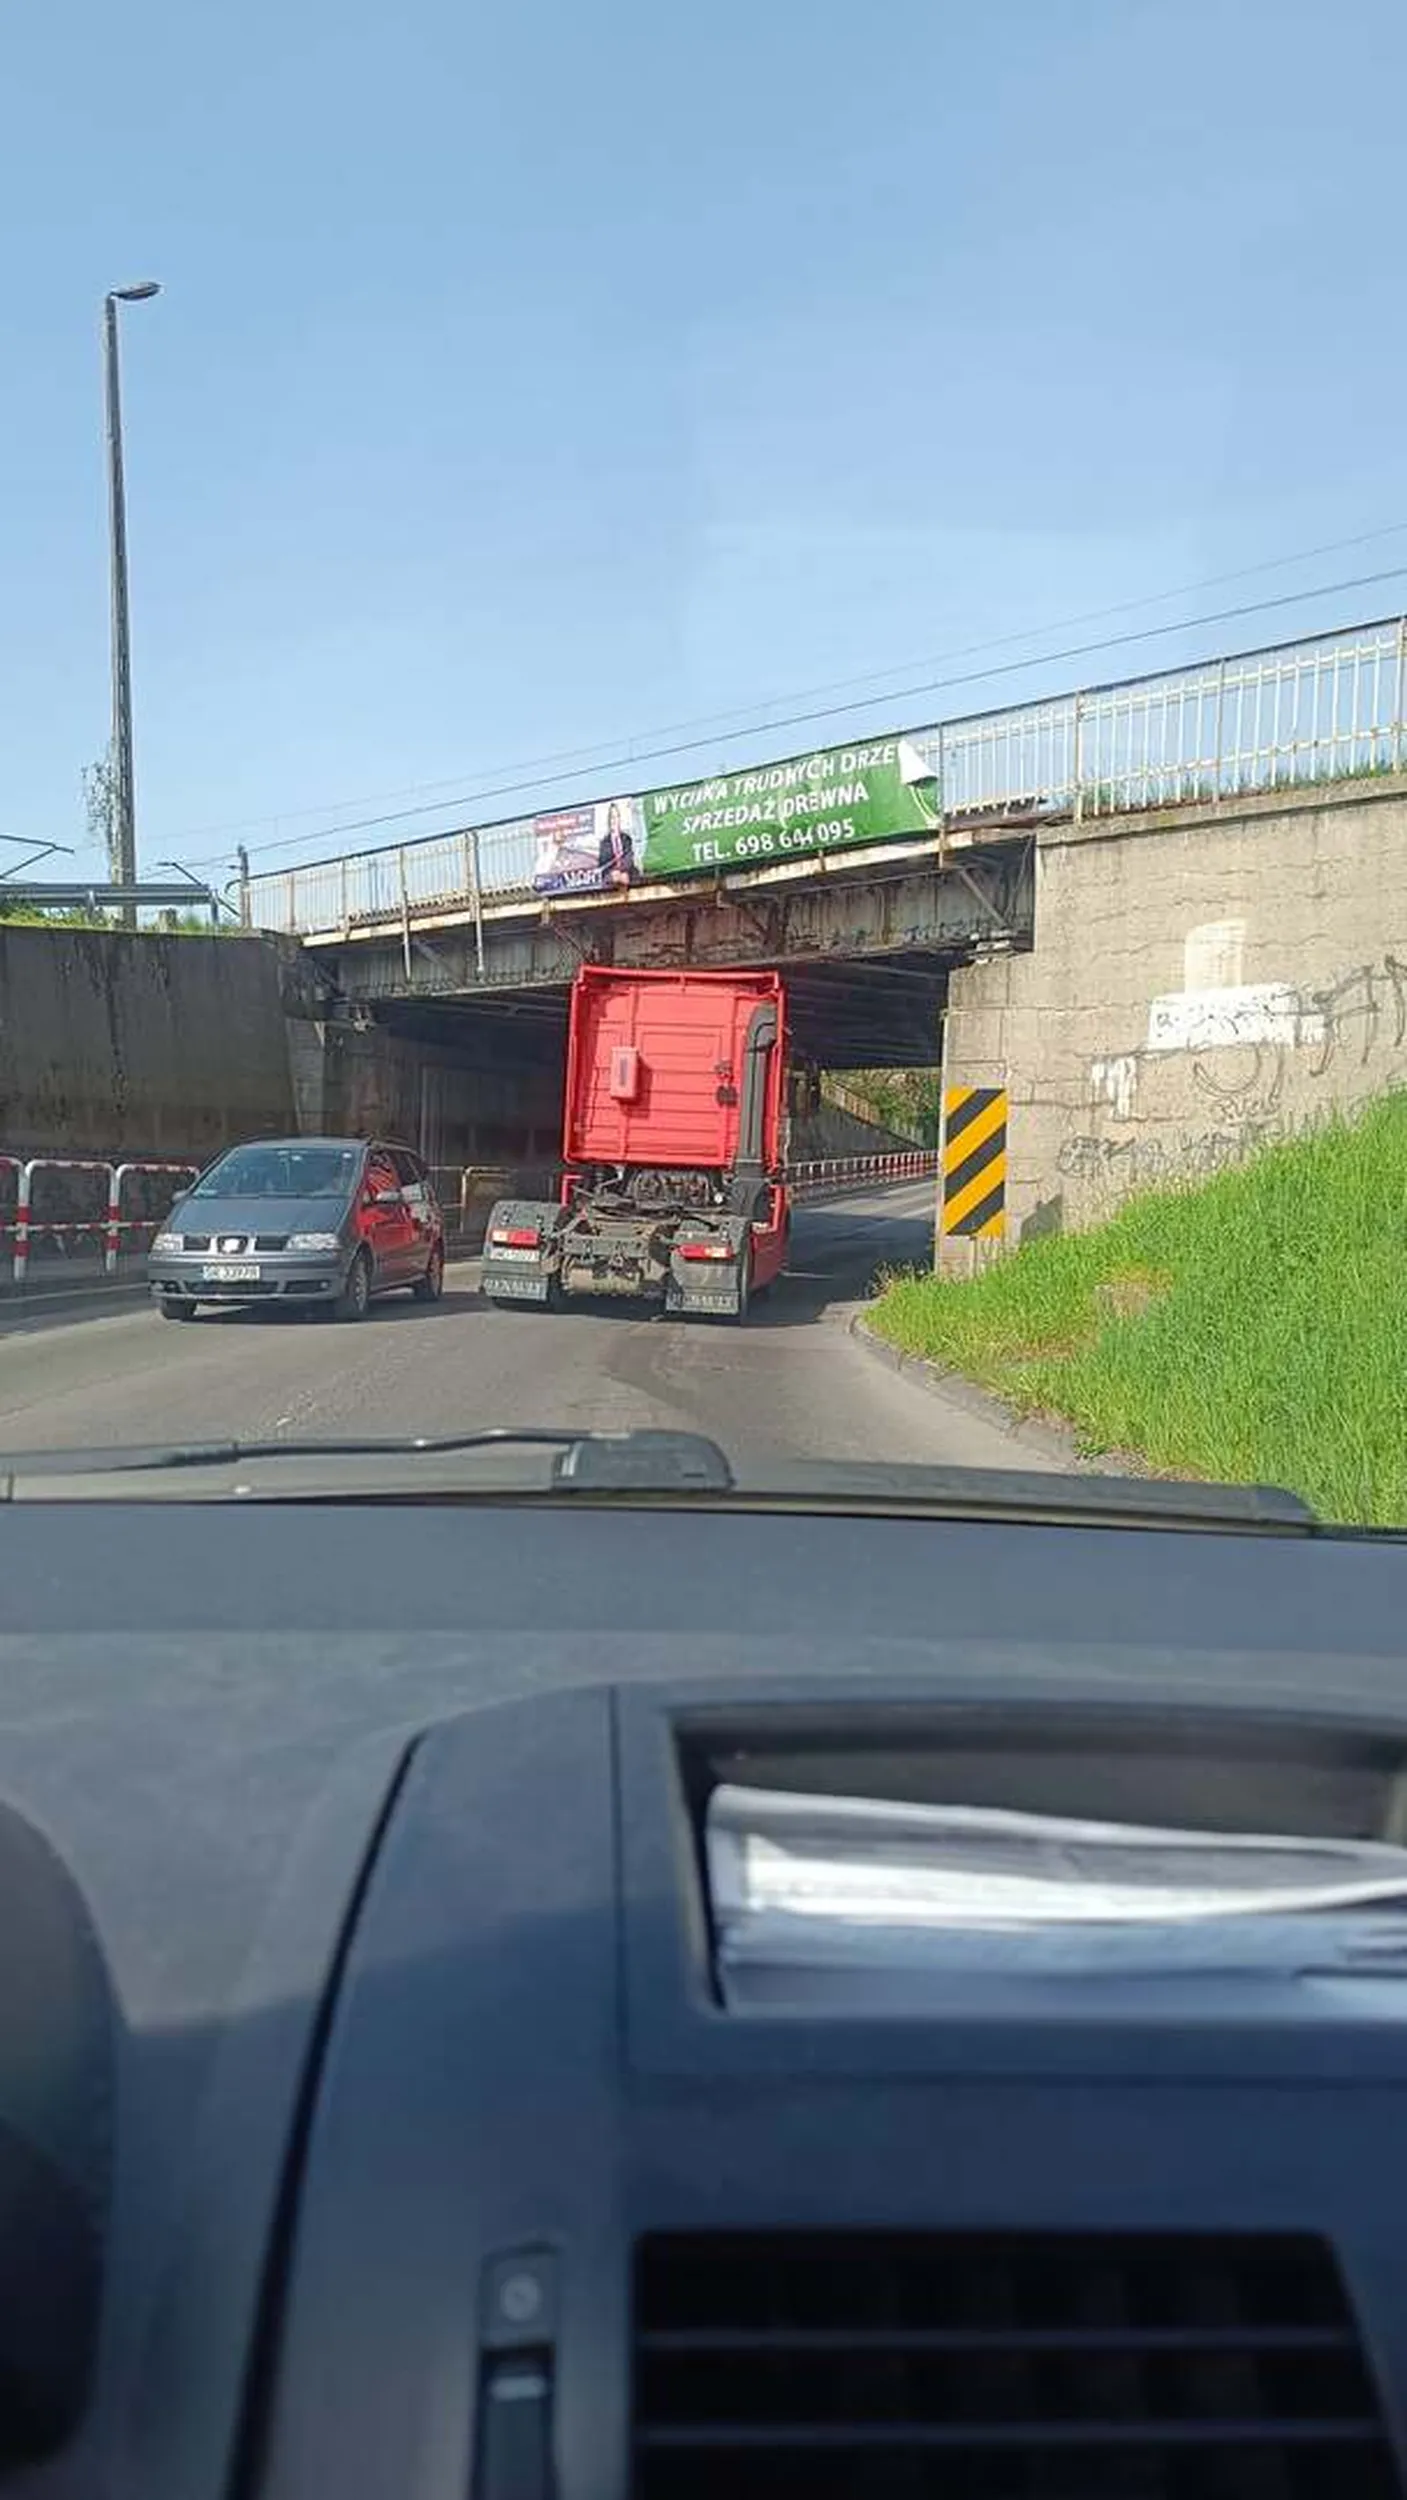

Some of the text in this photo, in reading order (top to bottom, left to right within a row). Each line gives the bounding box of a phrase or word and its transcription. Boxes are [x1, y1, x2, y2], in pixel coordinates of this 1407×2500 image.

[734, 757, 834, 796] TRUDNYCH
[840, 744, 896, 774] DRZE
[681, 780, 869, 835] SPRZEDAŻ DREWNA
[692, 839, 731, 861] TEL.
[735, 833, 774, 855] 698
[817, 818, 855, 841] 095
